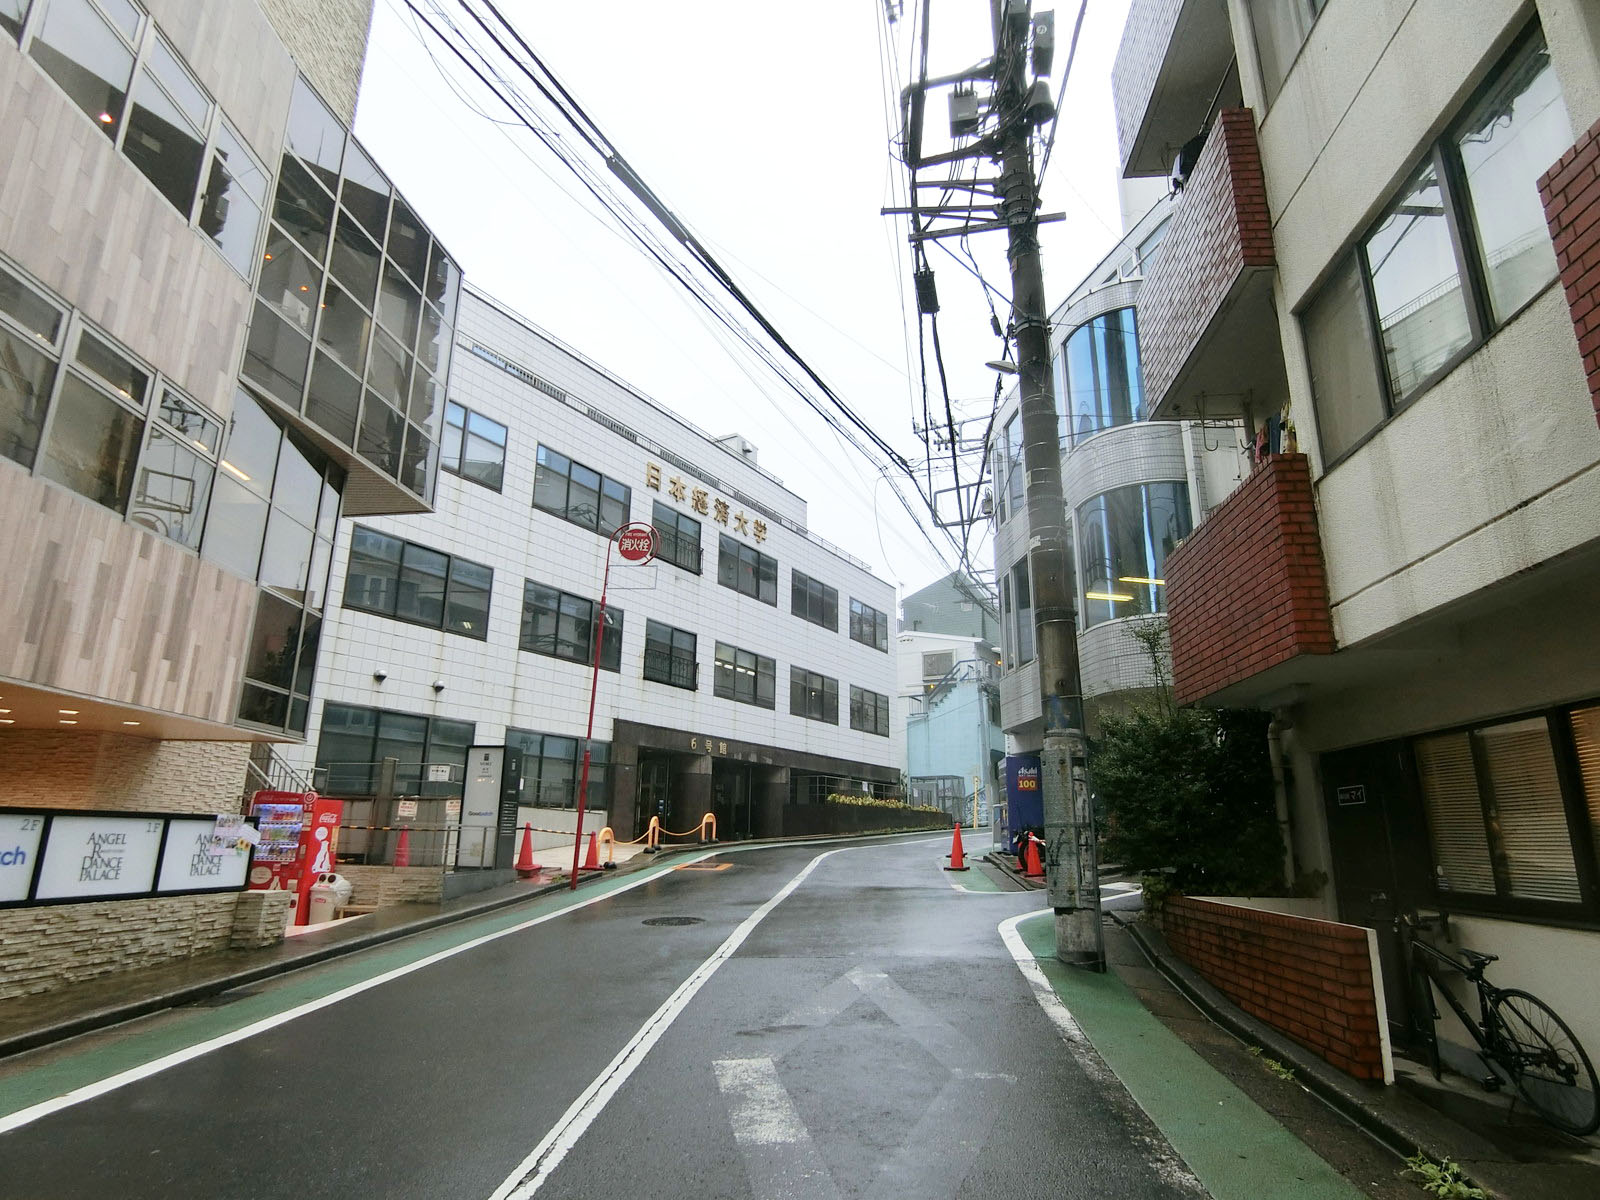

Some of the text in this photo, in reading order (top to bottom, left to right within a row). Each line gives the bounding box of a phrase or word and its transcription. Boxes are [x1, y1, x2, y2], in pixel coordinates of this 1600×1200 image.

[646, 461, 767, 544] 日本経済大学
[620, 538, 650, 552] 消火栓
[691, 738, 727, 755] 6号館
[1019, 780, 1035, 788] 100
[20, 818, 40, 831] 2F
[146, 822, 161, 833] 1F
[87, 832, 127, 845] ANGEL
[0, 846, 26, 865] ch
[192, 854, 223, 866] DANCE
[82, 856, 123, 869] DANCE
[79, 868, 121, 882] PALACE
[190, 864, 221, 876] PALACE
